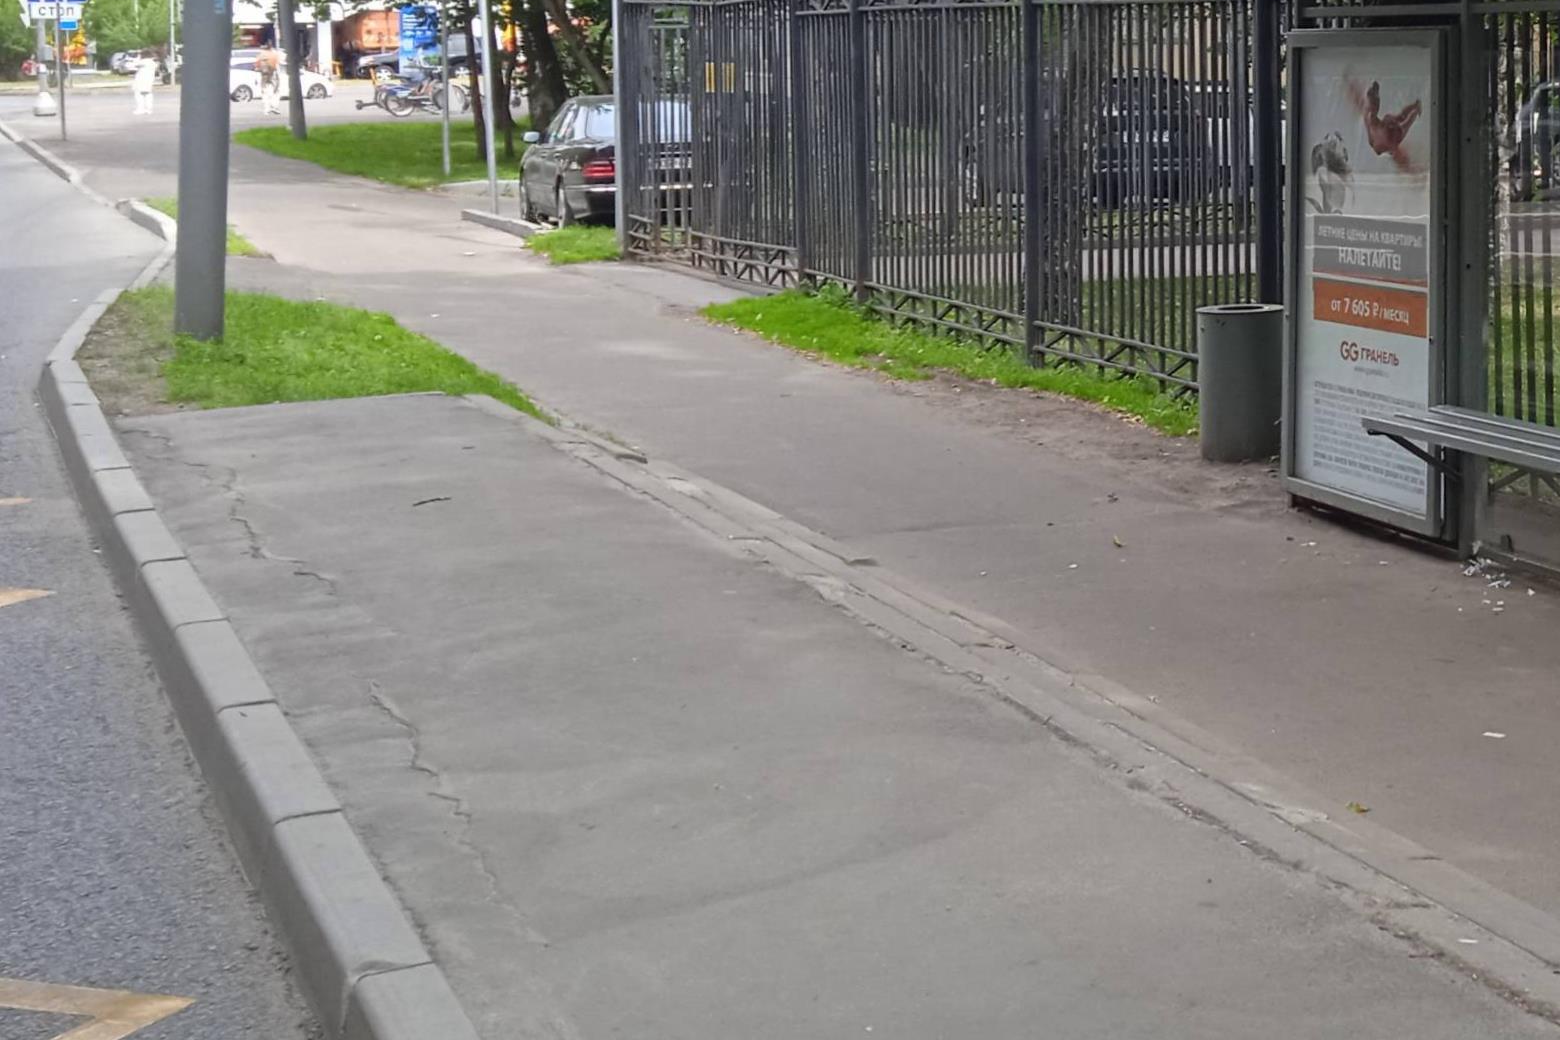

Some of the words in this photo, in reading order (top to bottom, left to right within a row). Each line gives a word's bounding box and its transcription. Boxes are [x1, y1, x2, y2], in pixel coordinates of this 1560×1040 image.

[38, 6, 74, 17] СТОП
[1318, 225, 1345, 240] ЛЕТНИЕ
[1347, 228, 1367, 242] ЦЕНЫ
[1369, 231, 1379, 243] НА
[1361, 347, 1399, 367] ГРАНЕЛЬ
